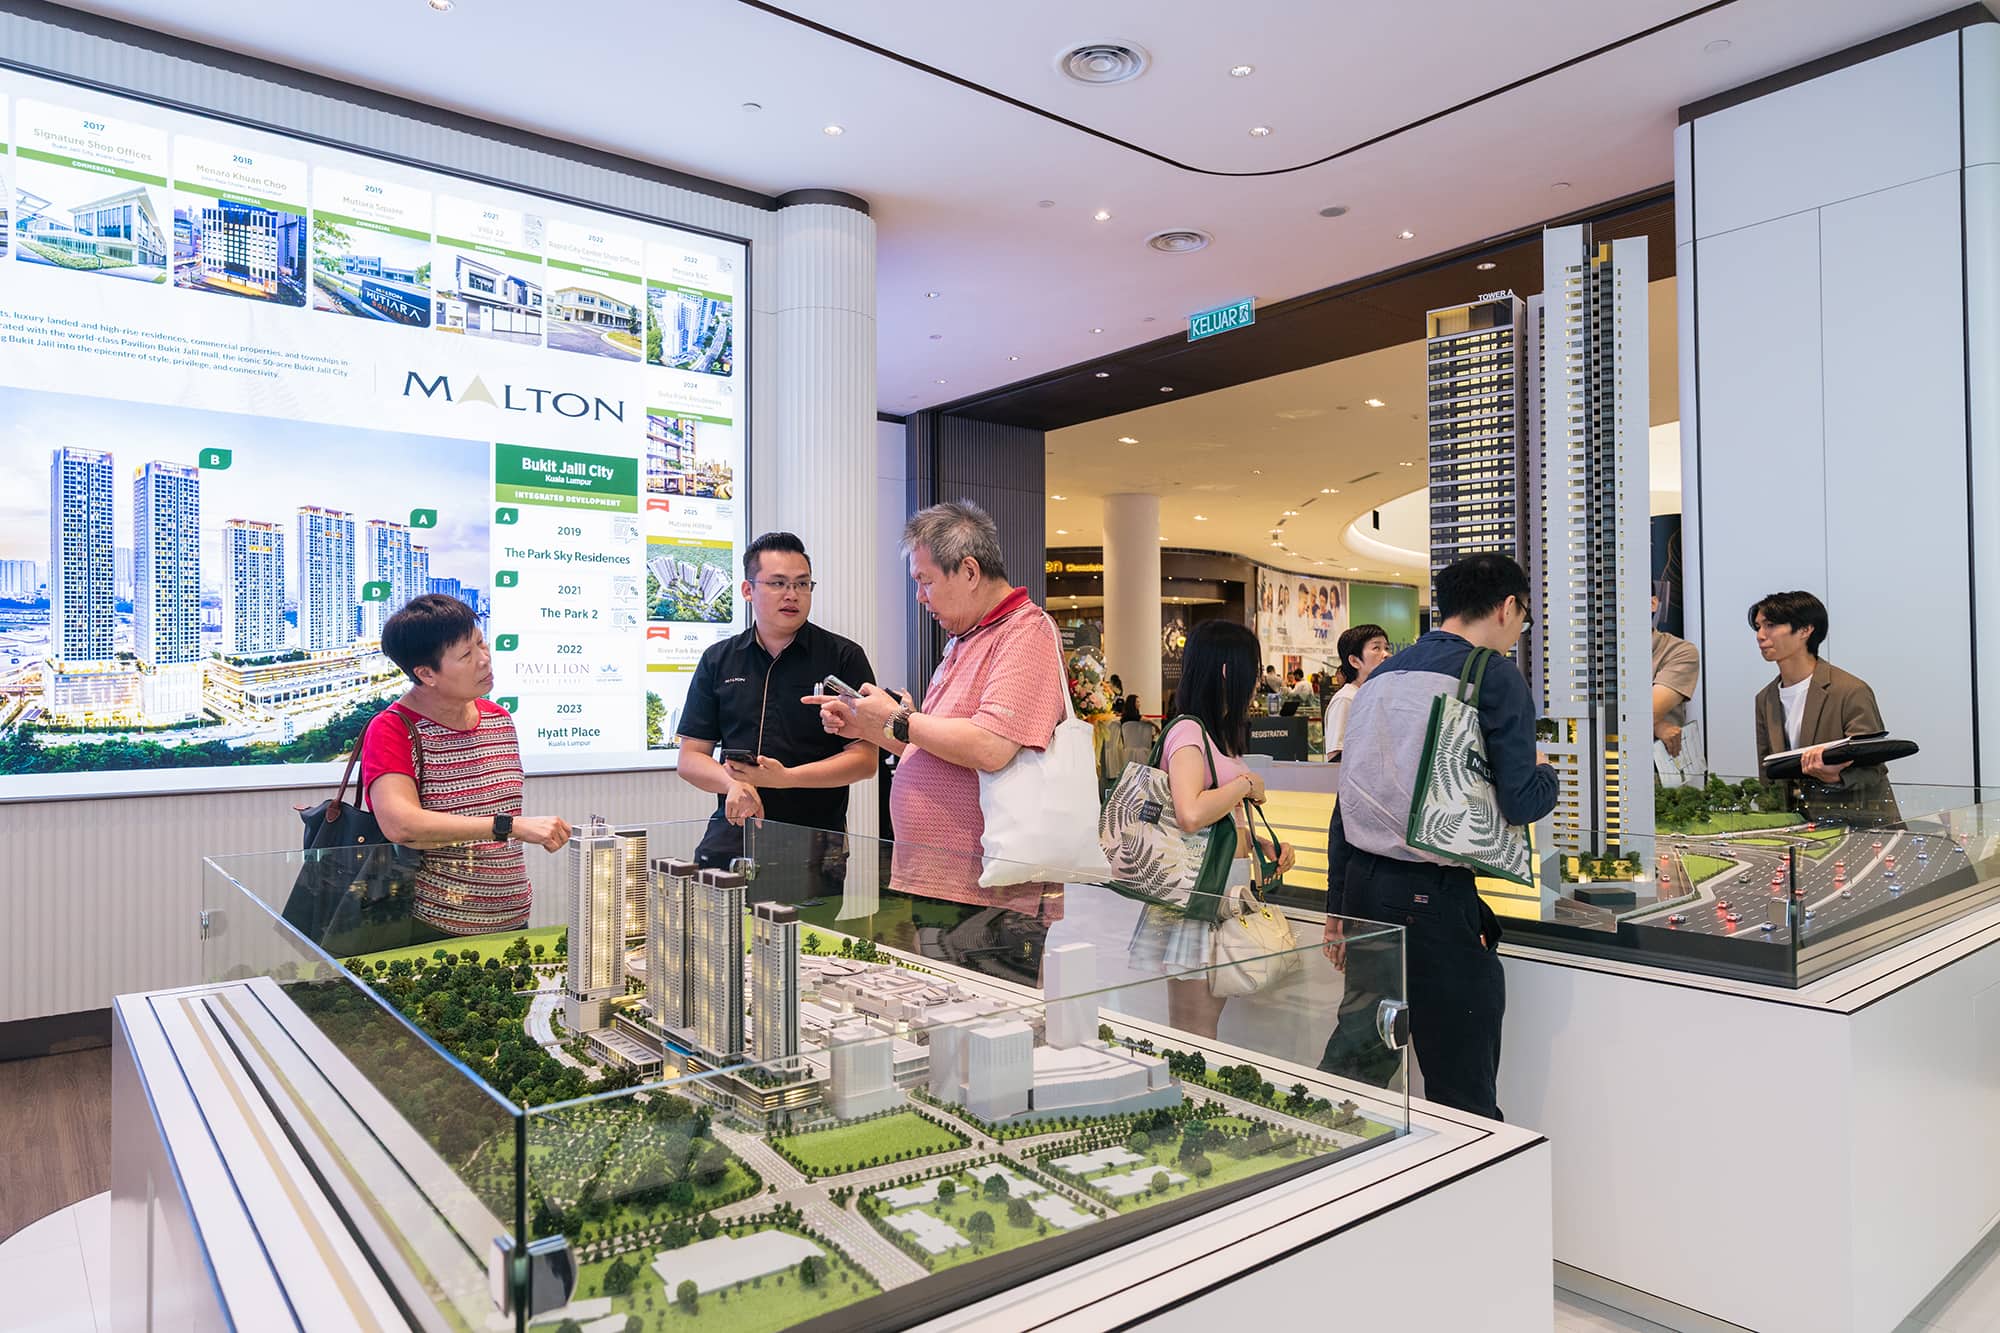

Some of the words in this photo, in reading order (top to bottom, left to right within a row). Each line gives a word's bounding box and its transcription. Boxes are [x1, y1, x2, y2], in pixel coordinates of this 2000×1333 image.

[83, 120, 105, 132] 2017
[34, 128, 85, 146] Signature
[88, 140, 114, 154] Shop
[117, 145, 152, 162] Offices
[232, 154, 253, 166] 2018
[196, 164, 231, 179] Menara
[232, 171, 262, 186] Khuan
[263, 178, 288, 191] Choo
[364, 184, 383, 195] 2019
[1477, 290, 1506, 301] TOWER
[1507, 288, 1514, 297] A
[366, 290, 421, 322] MUTIARA
[1192, 307, 1238, 337] KELUAR
[13, 311, 44, 324] luxury
[47, 316, 79, 328] landed
[81, 321, 98, 331] and
[100, 323, 139, 337] high-rise
[141, 330, 189, 344] residences,
[190, 338, 238, 351] commercial
[240, 345, 283, 358] properties,
[285, 351, 300, 360] and
[301, 354, 339, 367] townships
[9, 335, 34, 346] Bukit
[36, 338, 55, 349] Jalil
[56, 341, 76, 351] into
[77, 343, 93, 354] the
[94, 347, 137, 360] epicentre
[137, 351, 147, 360] of
[148, 354, 172, 367] style,
[172, 358, 211, 371] privilege,
[212, 362, 228, 372] and
[229, 365, 280, 381] connectivity.
[26, 325, 48, 336] with
[50, 328, 66, 338] the
[67, 332, 119, 346] world-class
[121, 338, 156, 351] Pavilion
[157, 344, 181, 354] Bukit
[183, 347, 199, 357] Jalil
[200, 350, 221, 361] mall,
[222, 353, 237, 362] the
[237, 355, 261, 366] iconic
[263, 358, 293, 370] 50-acre
[294, 362, 315, 373] Bukit
[317, 365, 331, 374] Jalil
[332, 368, 348, 379] City
[403, 370, 624, 423] MALTON
[210, 455, 220, 466] B
[522, 457, 557, 473] Bukit
[559, 461, 586, 476] Jalil
[589, 464, 614, 481] City
[545, 474, 565, 484] Kuala
[566, 476, 592, 486] Lumpur
[515, 490, 565, 502] INTEGRATED
[566, 494, 621, 507] DEVELOPMENT
[419, 515, 428, 525] A
[503, 512, 511, 522] A
[557, 526, 582, 537] 2019
[504, 547, 526, 559] The
[527, 548, 552, 560] Park
[553, 549, 573, 564] Sky
[574, 551, 631, 565] Residences
[503, 575, 511, 584] B
[372, 588, 381, 597] D
[557, 585, 582, 595] 2021
[540, 607, 561, 619] The
[564, 608, 589, 619] Park
[591, 609, 599, 620] 2
[503, 639, 511, 648] C
[556, 644, 583, 654] 2022
[515, 663, 591, 675] PAVILION
[556, 704, 583, 714] 2023
[537, 727, 569, 740] Hyatt
[571, 727, 601, 737] Place
[1251, 730, 1289, 739] REGISTRATION
[548, 740, 566, 748] Kuala
[567, 740, 591, 749] Lumpur
